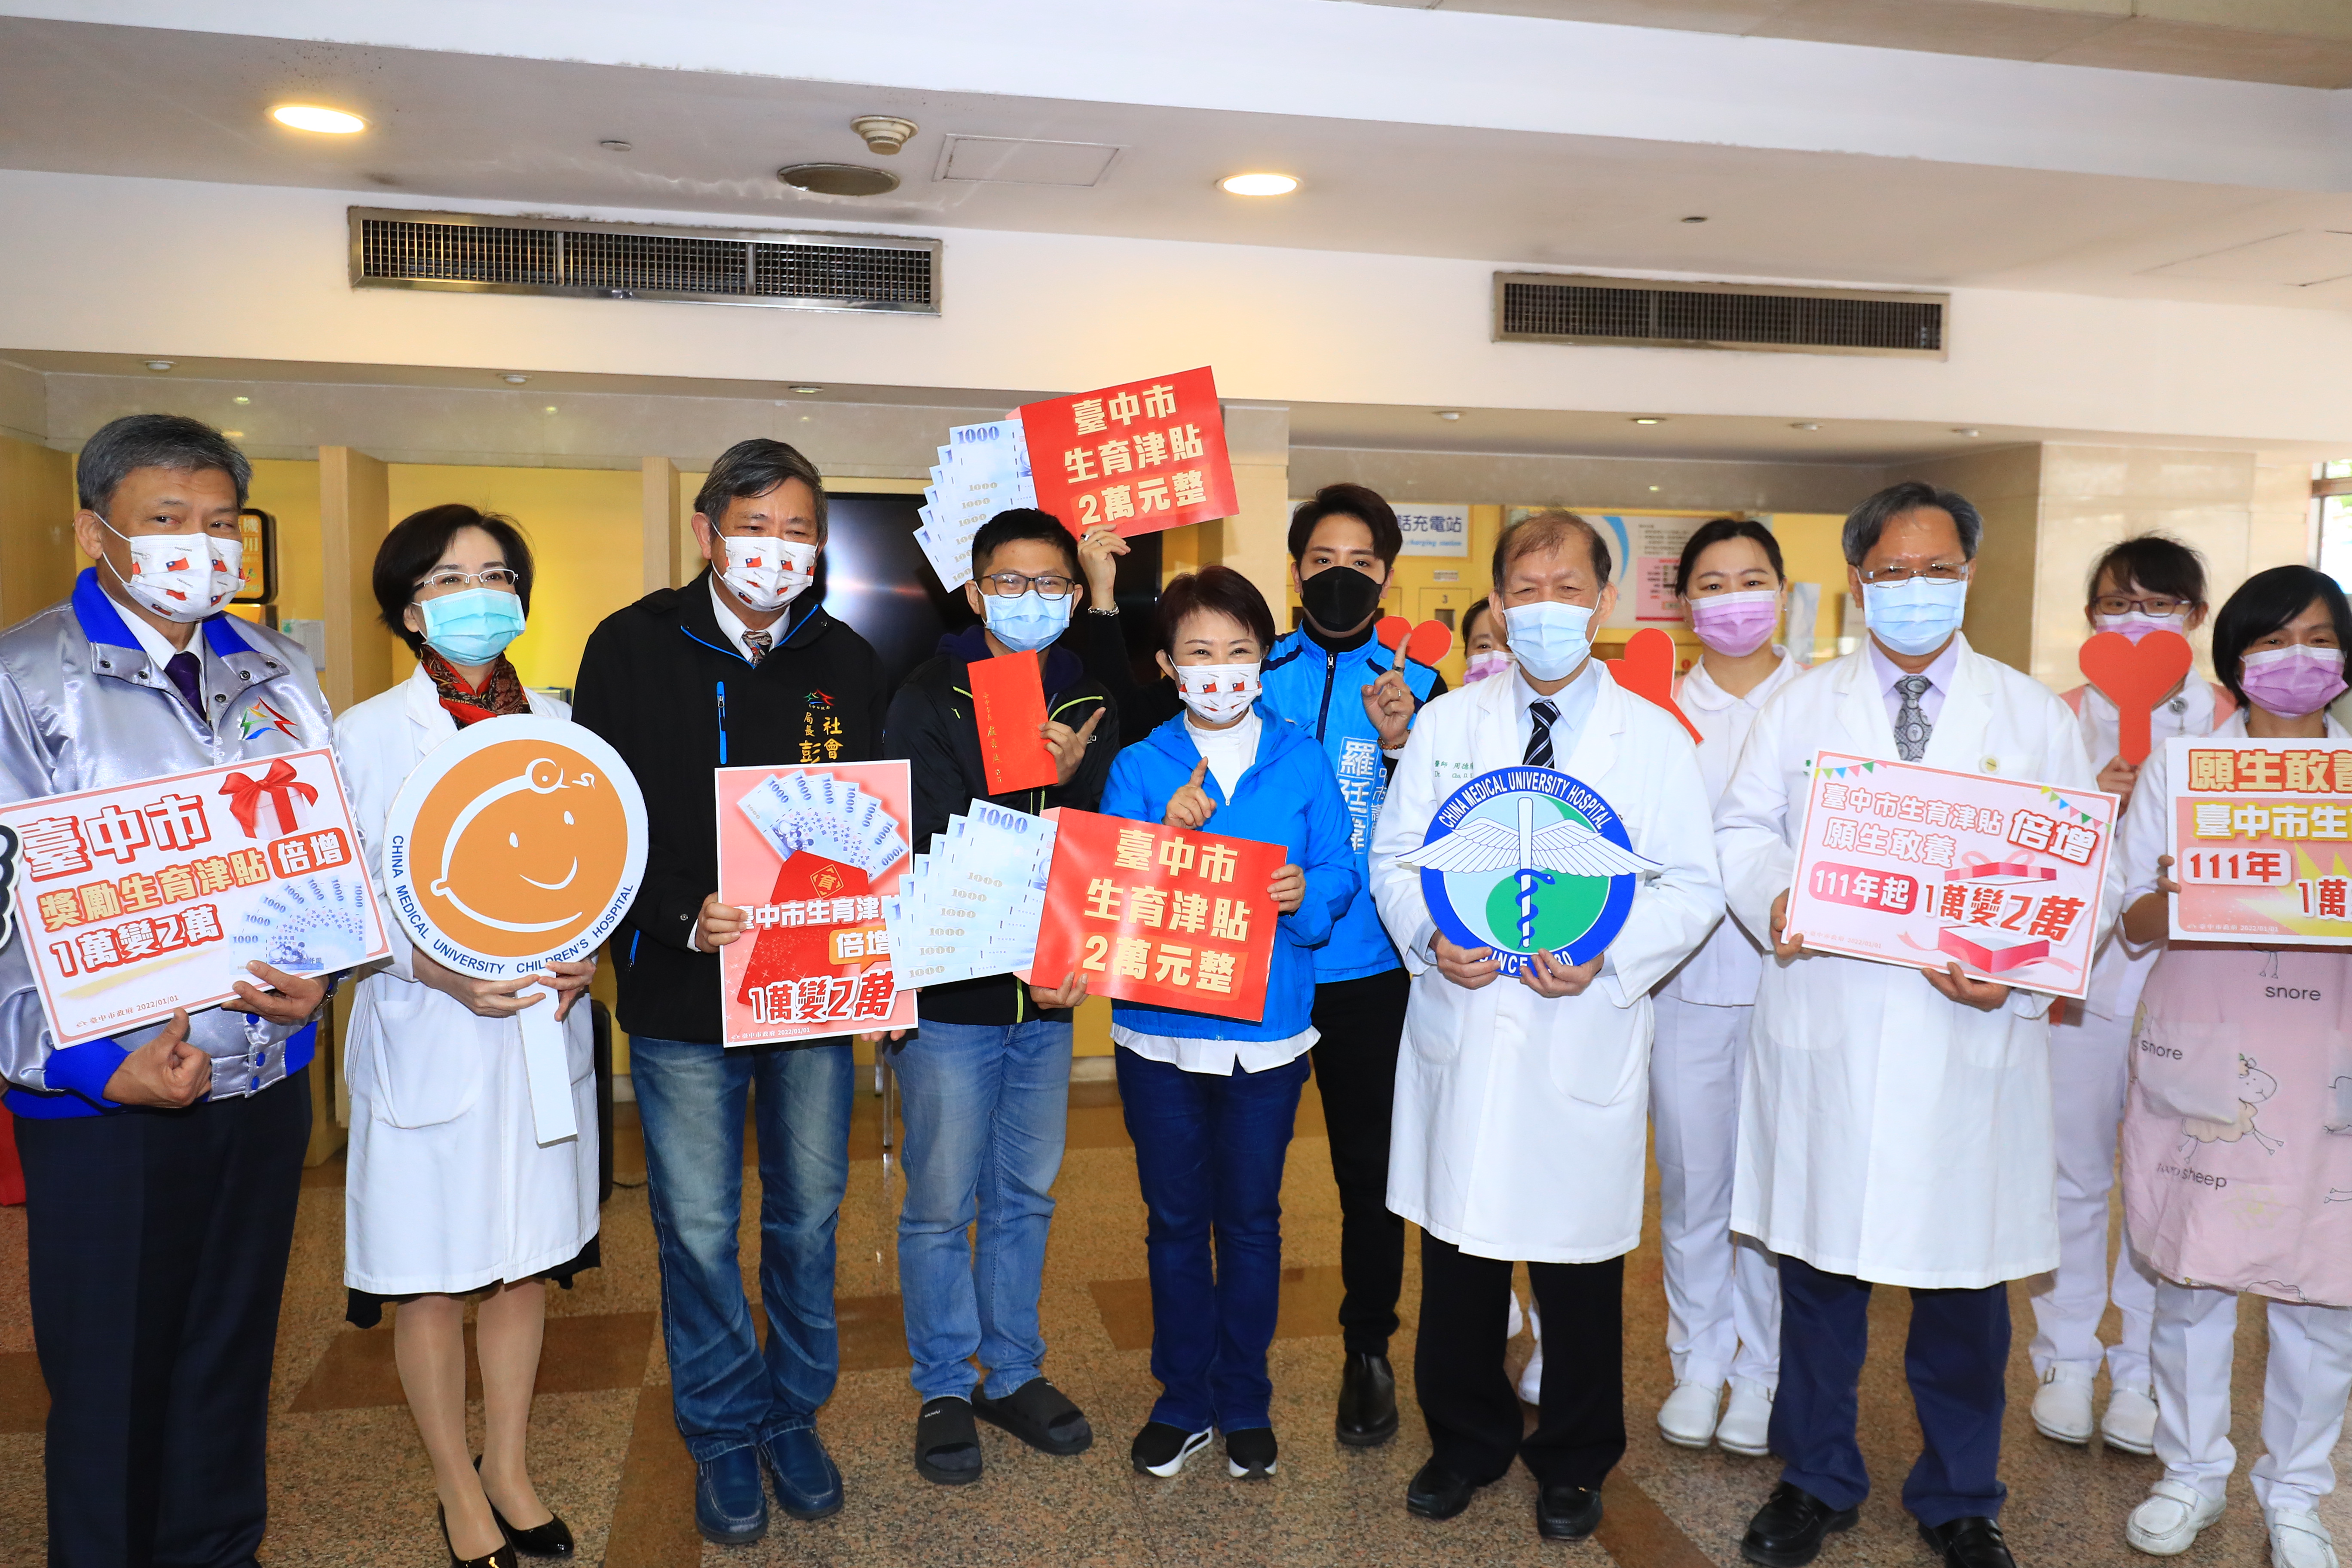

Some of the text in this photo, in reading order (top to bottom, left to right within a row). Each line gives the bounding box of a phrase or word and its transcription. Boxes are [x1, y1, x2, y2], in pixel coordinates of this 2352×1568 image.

[1072, 384, 1176, 436] 臺中市
[957, 426, 999, 444] 1000
[1064, 424, 1204, 484] 生育津貼
[969, 482, 997, 491] 1000
[1077, 469, 1207, 525] 2萬元整
[962, 498, 990, 509] 1000
[959, 514, 986, 527] 1000
[1442, 594, 1448, 604] 3
[767, 780, 789, 803] 1000
[795, 775, 812, 801] 1000
[823, 778, 834, 804] 1000
[845, 787, 856, 813] 1000
[1439, 772, 1612, 829] CHINA MEDICAL UNIVERSITY HOSPITAL
[746, 804, 760, 819] 1000
[862, 801, 877, 827] 1000
[976, 806, 1028, 833] 1000
[1821, 783, 2098, 866] 臺中市生育津貼 倍增
[2196, 804, 2352, 839] 臺中市生
[19, 794, 211, 882] 臺中市
[874, 821, 894, 845] 1000
[1823, 817, 1957, 868] 願生敢養
[392, 835, 404, 879] CHINA
[881, 845, 903, 867] 1000
[1115, 829, 1239, 884] 臺中市
[2191, 851, 2281, 882] 111年
[37, 833, 344, 933] 獎勵生育津貼 倍增
[308, 879, 324, 900] 1000
[331, 879, 344, 901] 1000
[818, 873, 837, 891] 育
[968, 873, 1003, 887] 1000
[263, 897, 286, 913] 1000
[284, 885, 304, 904] 1000
[952, 889, 987, 902] 1000
[1814, 869, 2089, 943] 111年起 1萬變2萬
[2298, 879, 2352, 918] 1萬
[245, 914, 270, 926] 1000
[395, 885, 429, 940] MEDICAL
[592, 884, 634, 938] HOSPITAL
[733, 894, 900, 930] 中市生育津
[940, 908, 976, 918] 1000
[1084, 879, 1251, 942] 生育津貼
[50, 904, 223, 977] 1萬變2萬
[919, 946, 955, 956] 1000
[433, 938, 505, 974] UNIVERSITY
[1082, 936, 1236, 994] 2萬元整
[1479, 950, 1528, 974] INCE
[909, 966, 945, 978] 1000
[750, 969, 896, 1023] 1萬變2萬
[2265, 986, 2321, 1001] snore
[90, 995, 179, 1023] 臺中市政府 2022/01/01
[778, 1028, 810, 1036] 2022/01/01
[2141, 1039, 2183, 1060] snore
[2182, 1167, 2226, 1190] sheep
